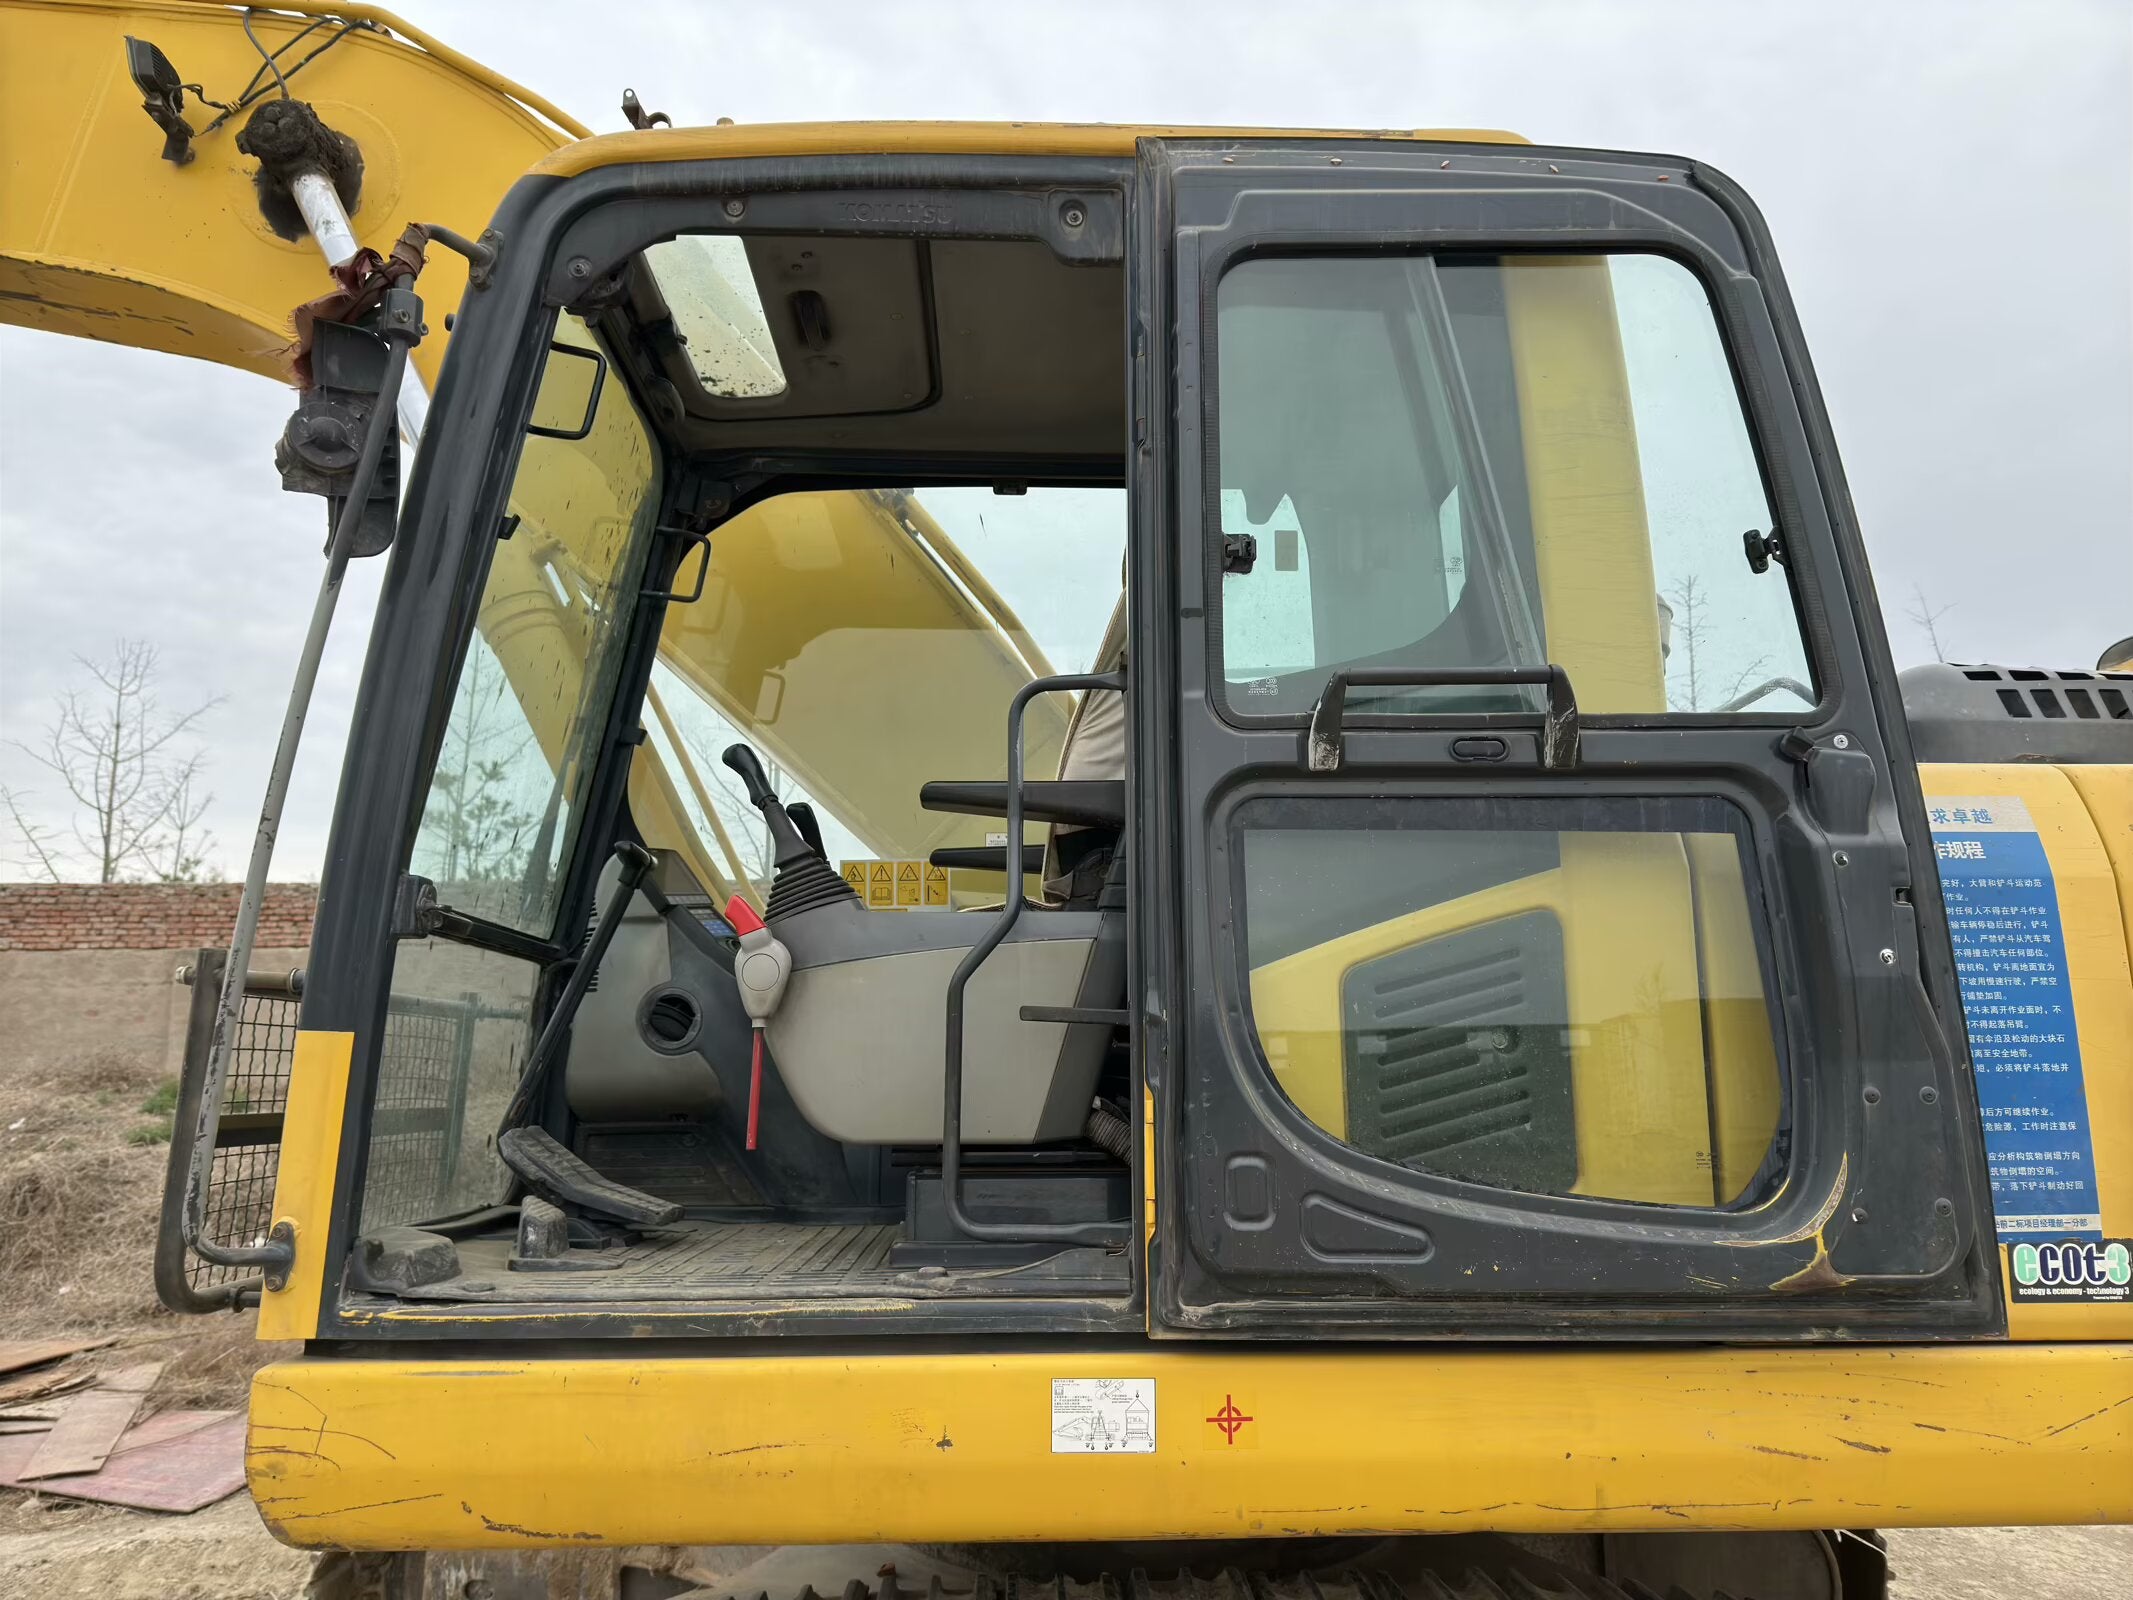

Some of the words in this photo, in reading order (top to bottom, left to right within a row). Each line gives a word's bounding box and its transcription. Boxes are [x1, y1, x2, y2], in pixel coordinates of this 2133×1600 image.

[1929, 808, 1993, 824] 求卓越
[1943, 893, 1970, 901] 作业。
[1949, 920, 2048, 929] 输车辆停稳后进行，铲斗
[1970, 1049, 2033, 1058] 离至安全地带。
[1973, 1063, 2069, 1073] 短，必须将铲斗落地并
[1983, 1122, 2077, 1131] 危险源，工作时注意保
[2013, 1243, 2131, 1285] ecot3
[2019, 1287, 2045, 1296] ecology
[2052, 1288, 2082, 1296] economy
[2087, 1287, 2124, 1296] technology
[2124, 1287, 2130, 1295] 3
